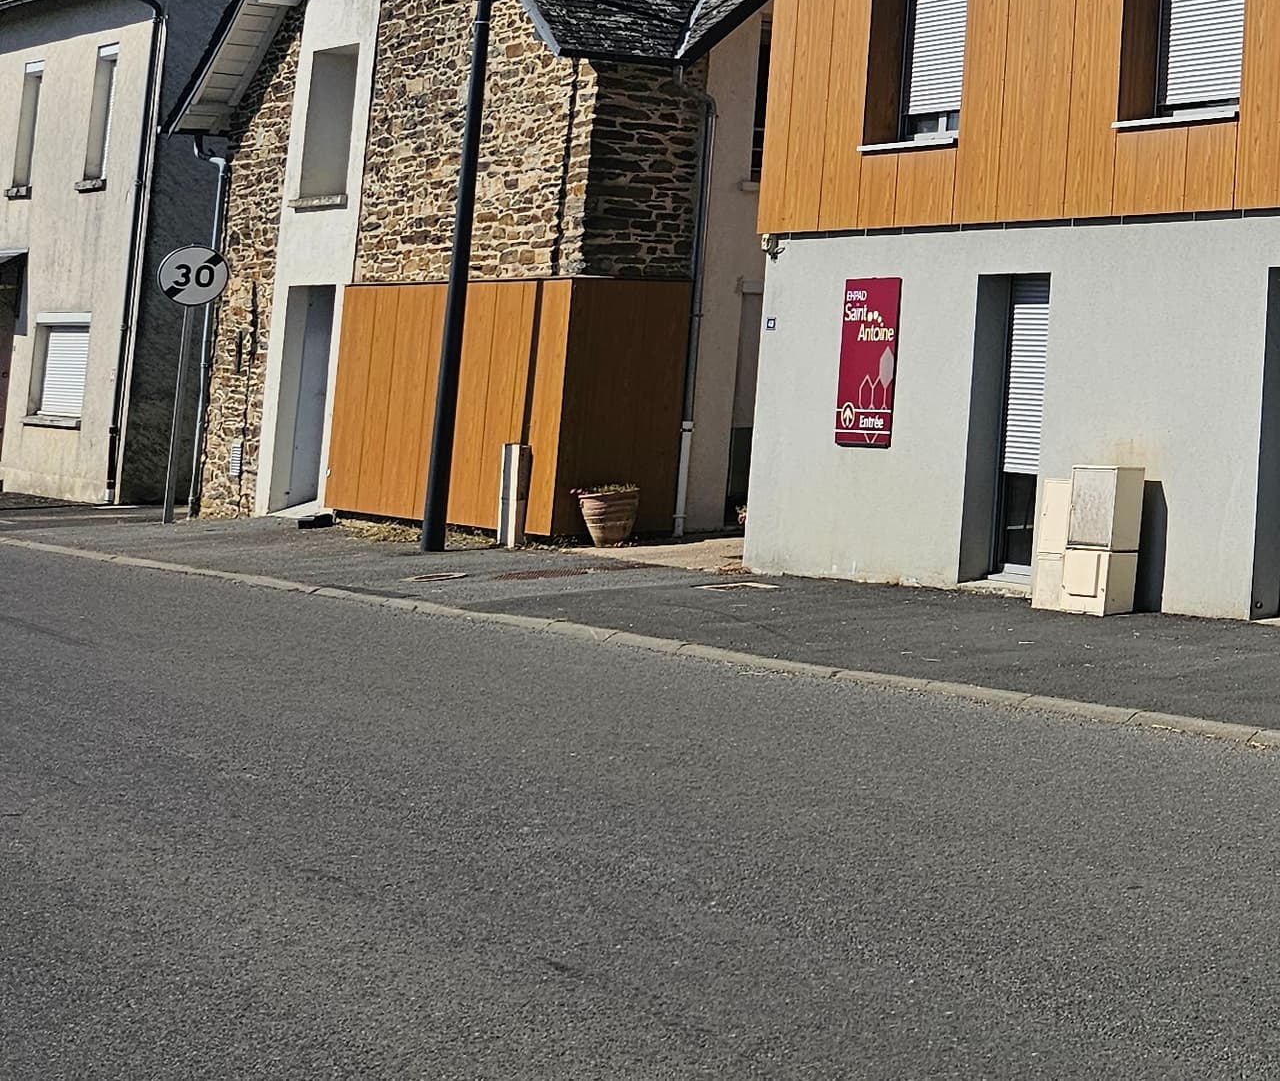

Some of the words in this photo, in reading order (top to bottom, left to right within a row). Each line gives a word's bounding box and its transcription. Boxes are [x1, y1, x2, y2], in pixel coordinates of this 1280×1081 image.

[172, 263, 215, 288] 30
[846, 290, 867, 301] EHPAD
[845, 302, 867, 321] Saint
[857, 322, 894, 341] Antoine
[859, 414, 884, 429] Entrée
